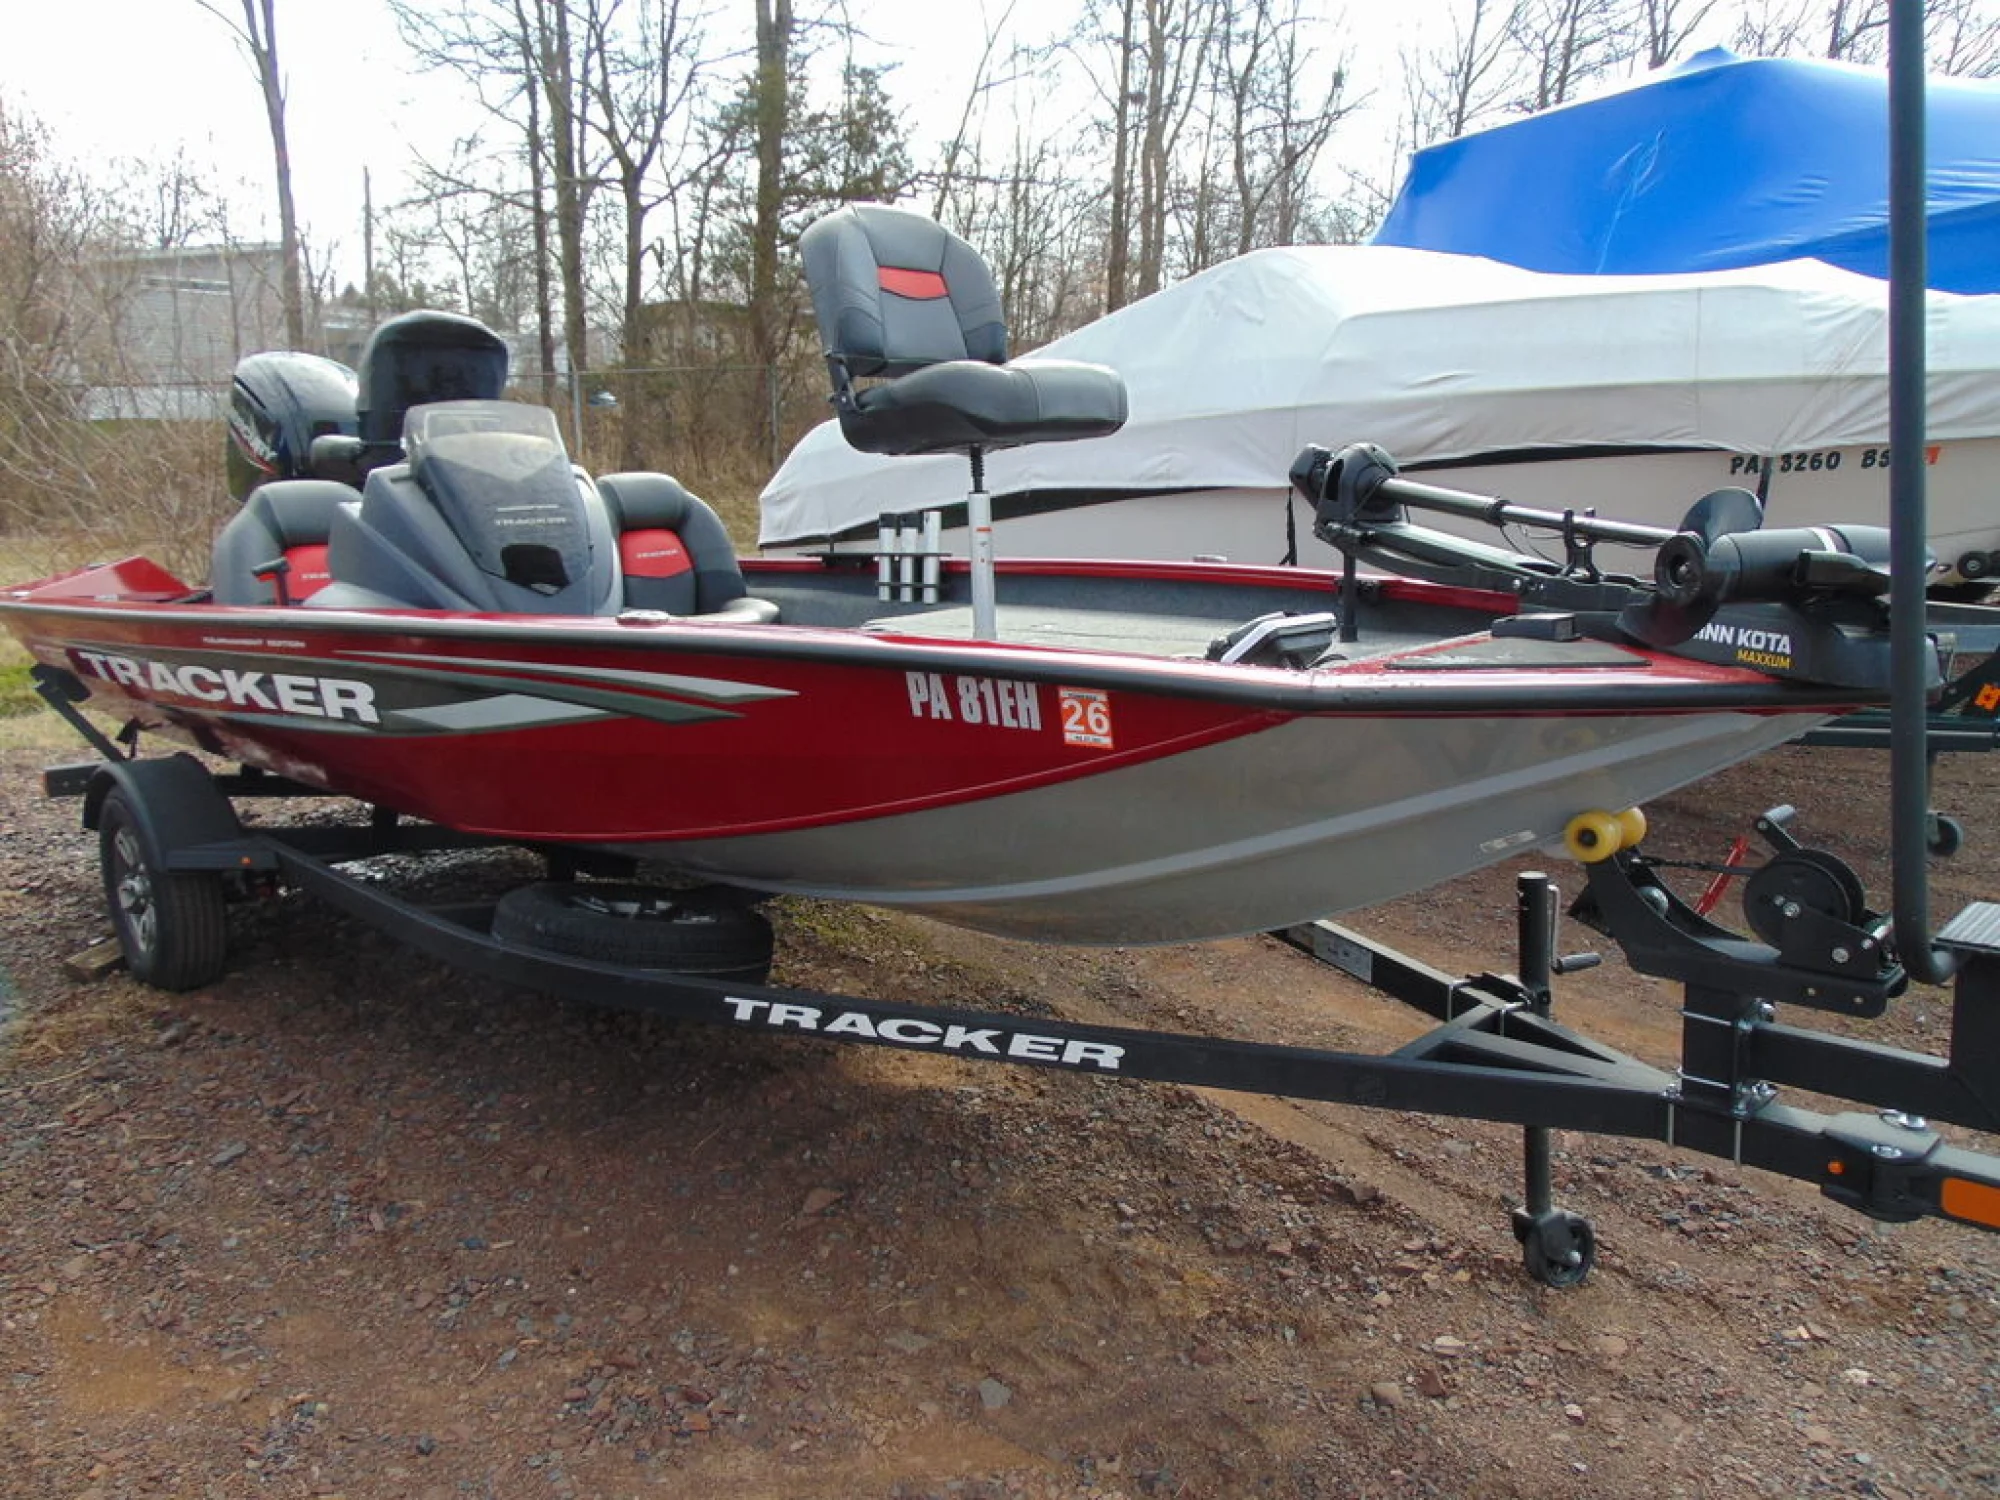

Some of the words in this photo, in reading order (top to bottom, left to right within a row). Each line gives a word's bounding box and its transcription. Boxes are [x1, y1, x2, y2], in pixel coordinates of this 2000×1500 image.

[1730, 454, 1759, 475] PA
[1780, 452, 1841, 473] 3260
[1692, 622, 1735, 645] INN
[1737, 628, 1791, 655] KOTA
[1736, 649, 1791, 670] MAXXUM
[78, 651, 380, 723] TRACKER
[905, 671, 952, 720] PA
[957, 675, 1042, 731] 81EH
[1062, 699, 1110, 735] 26
[724, 996, 1126, 1069] TRACKER
